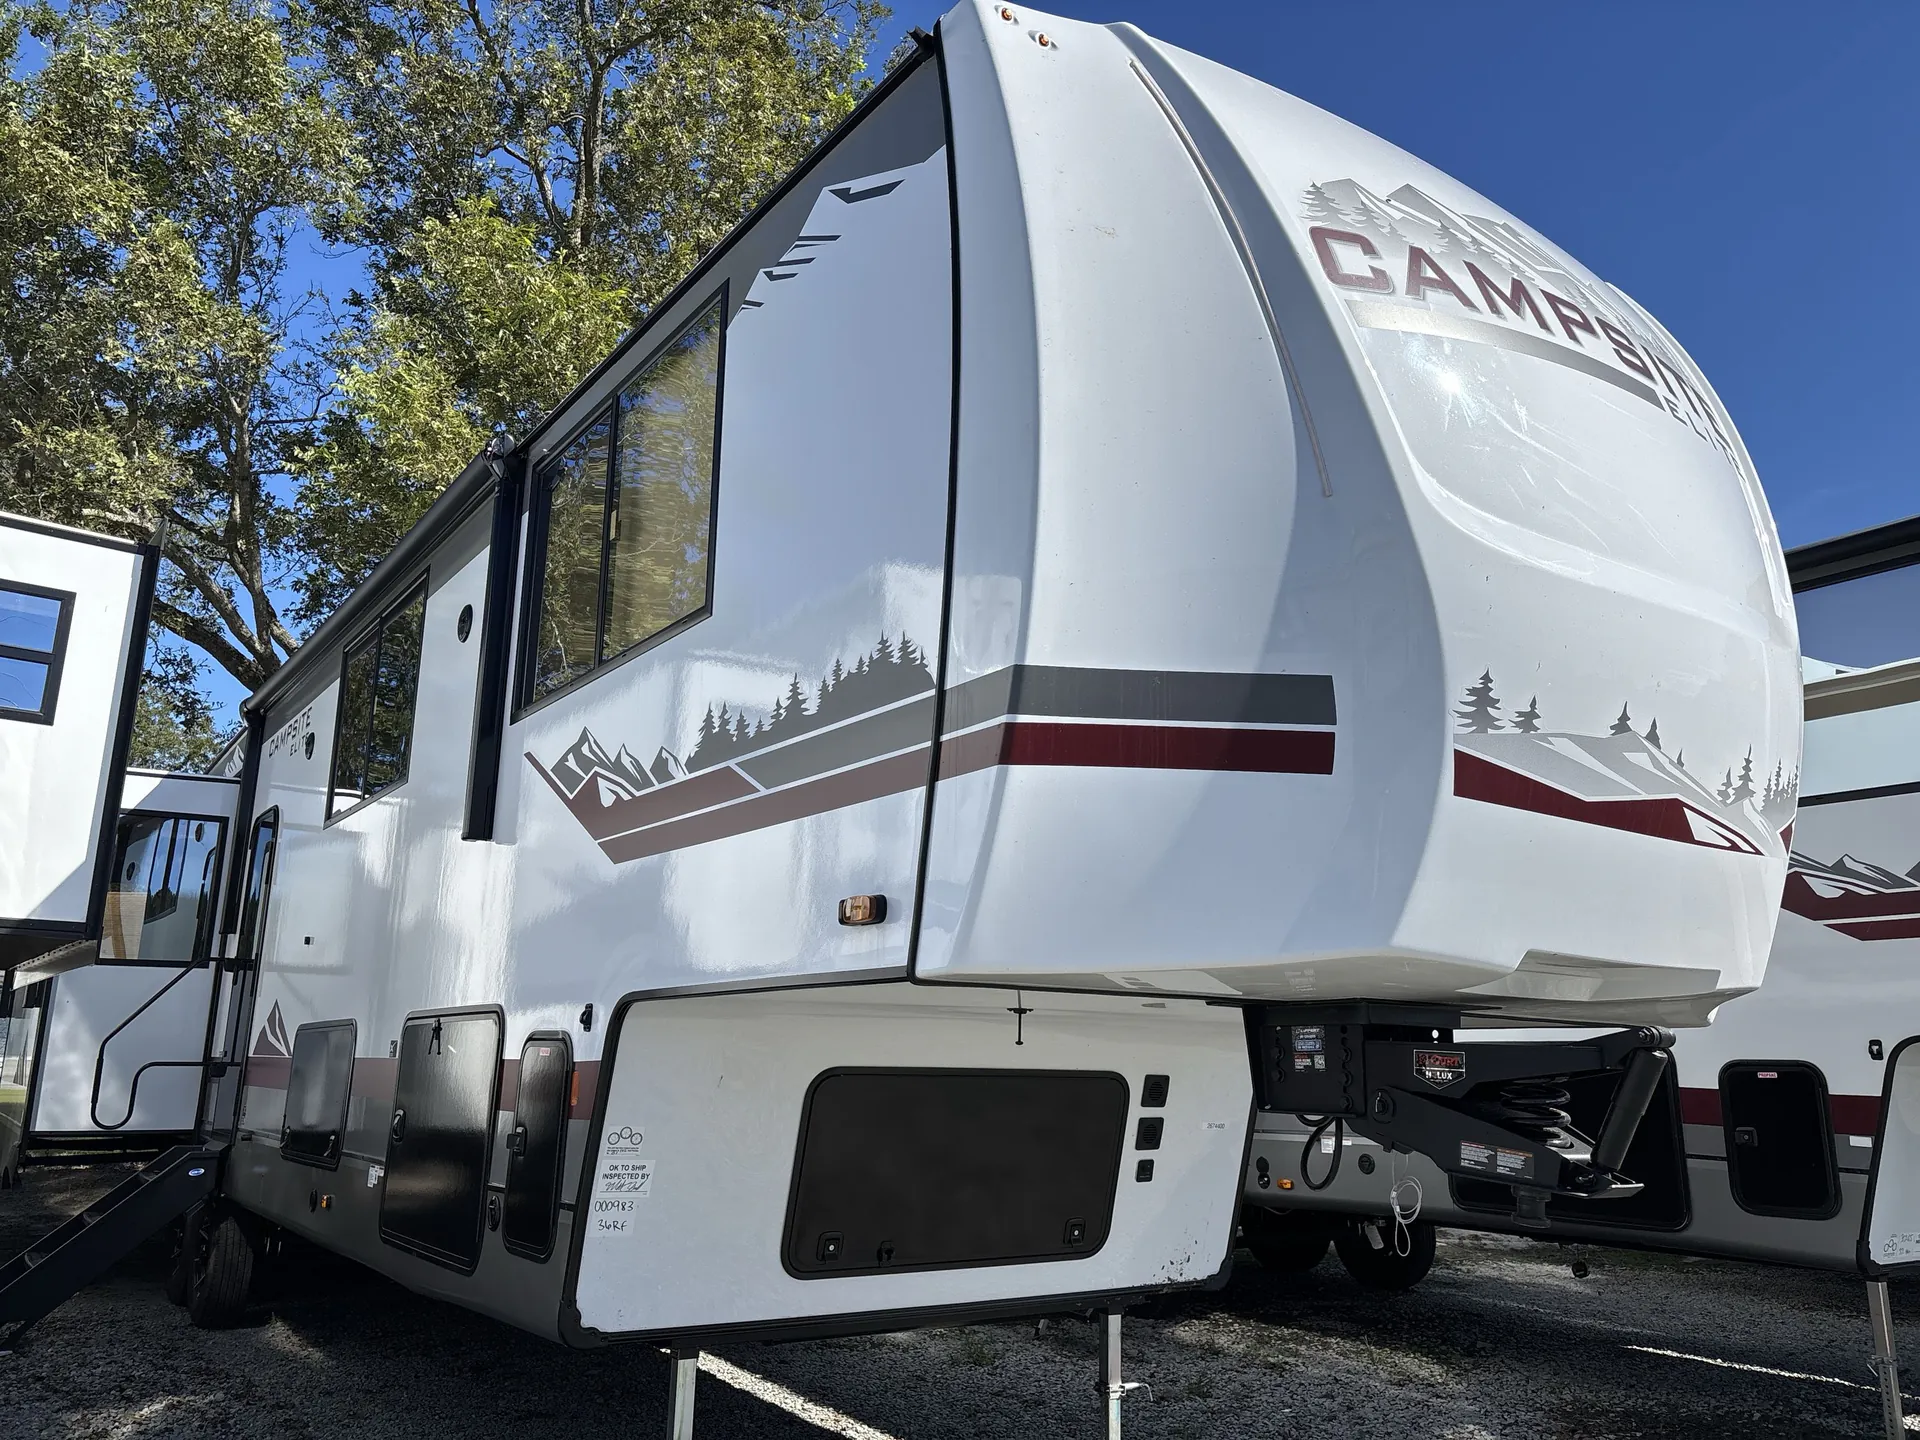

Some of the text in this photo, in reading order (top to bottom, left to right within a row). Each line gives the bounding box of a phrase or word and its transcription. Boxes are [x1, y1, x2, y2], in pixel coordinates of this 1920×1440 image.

[1308, 225, 1734, 455] CAMPSITE
[1662, 395, 1746, 482] ELITE
[268, 706, 312, 758] CAMPSITE
[602, 1172, 650, 1180] INSPECTED BY
[595, 1200, 634, 1212] 000983
